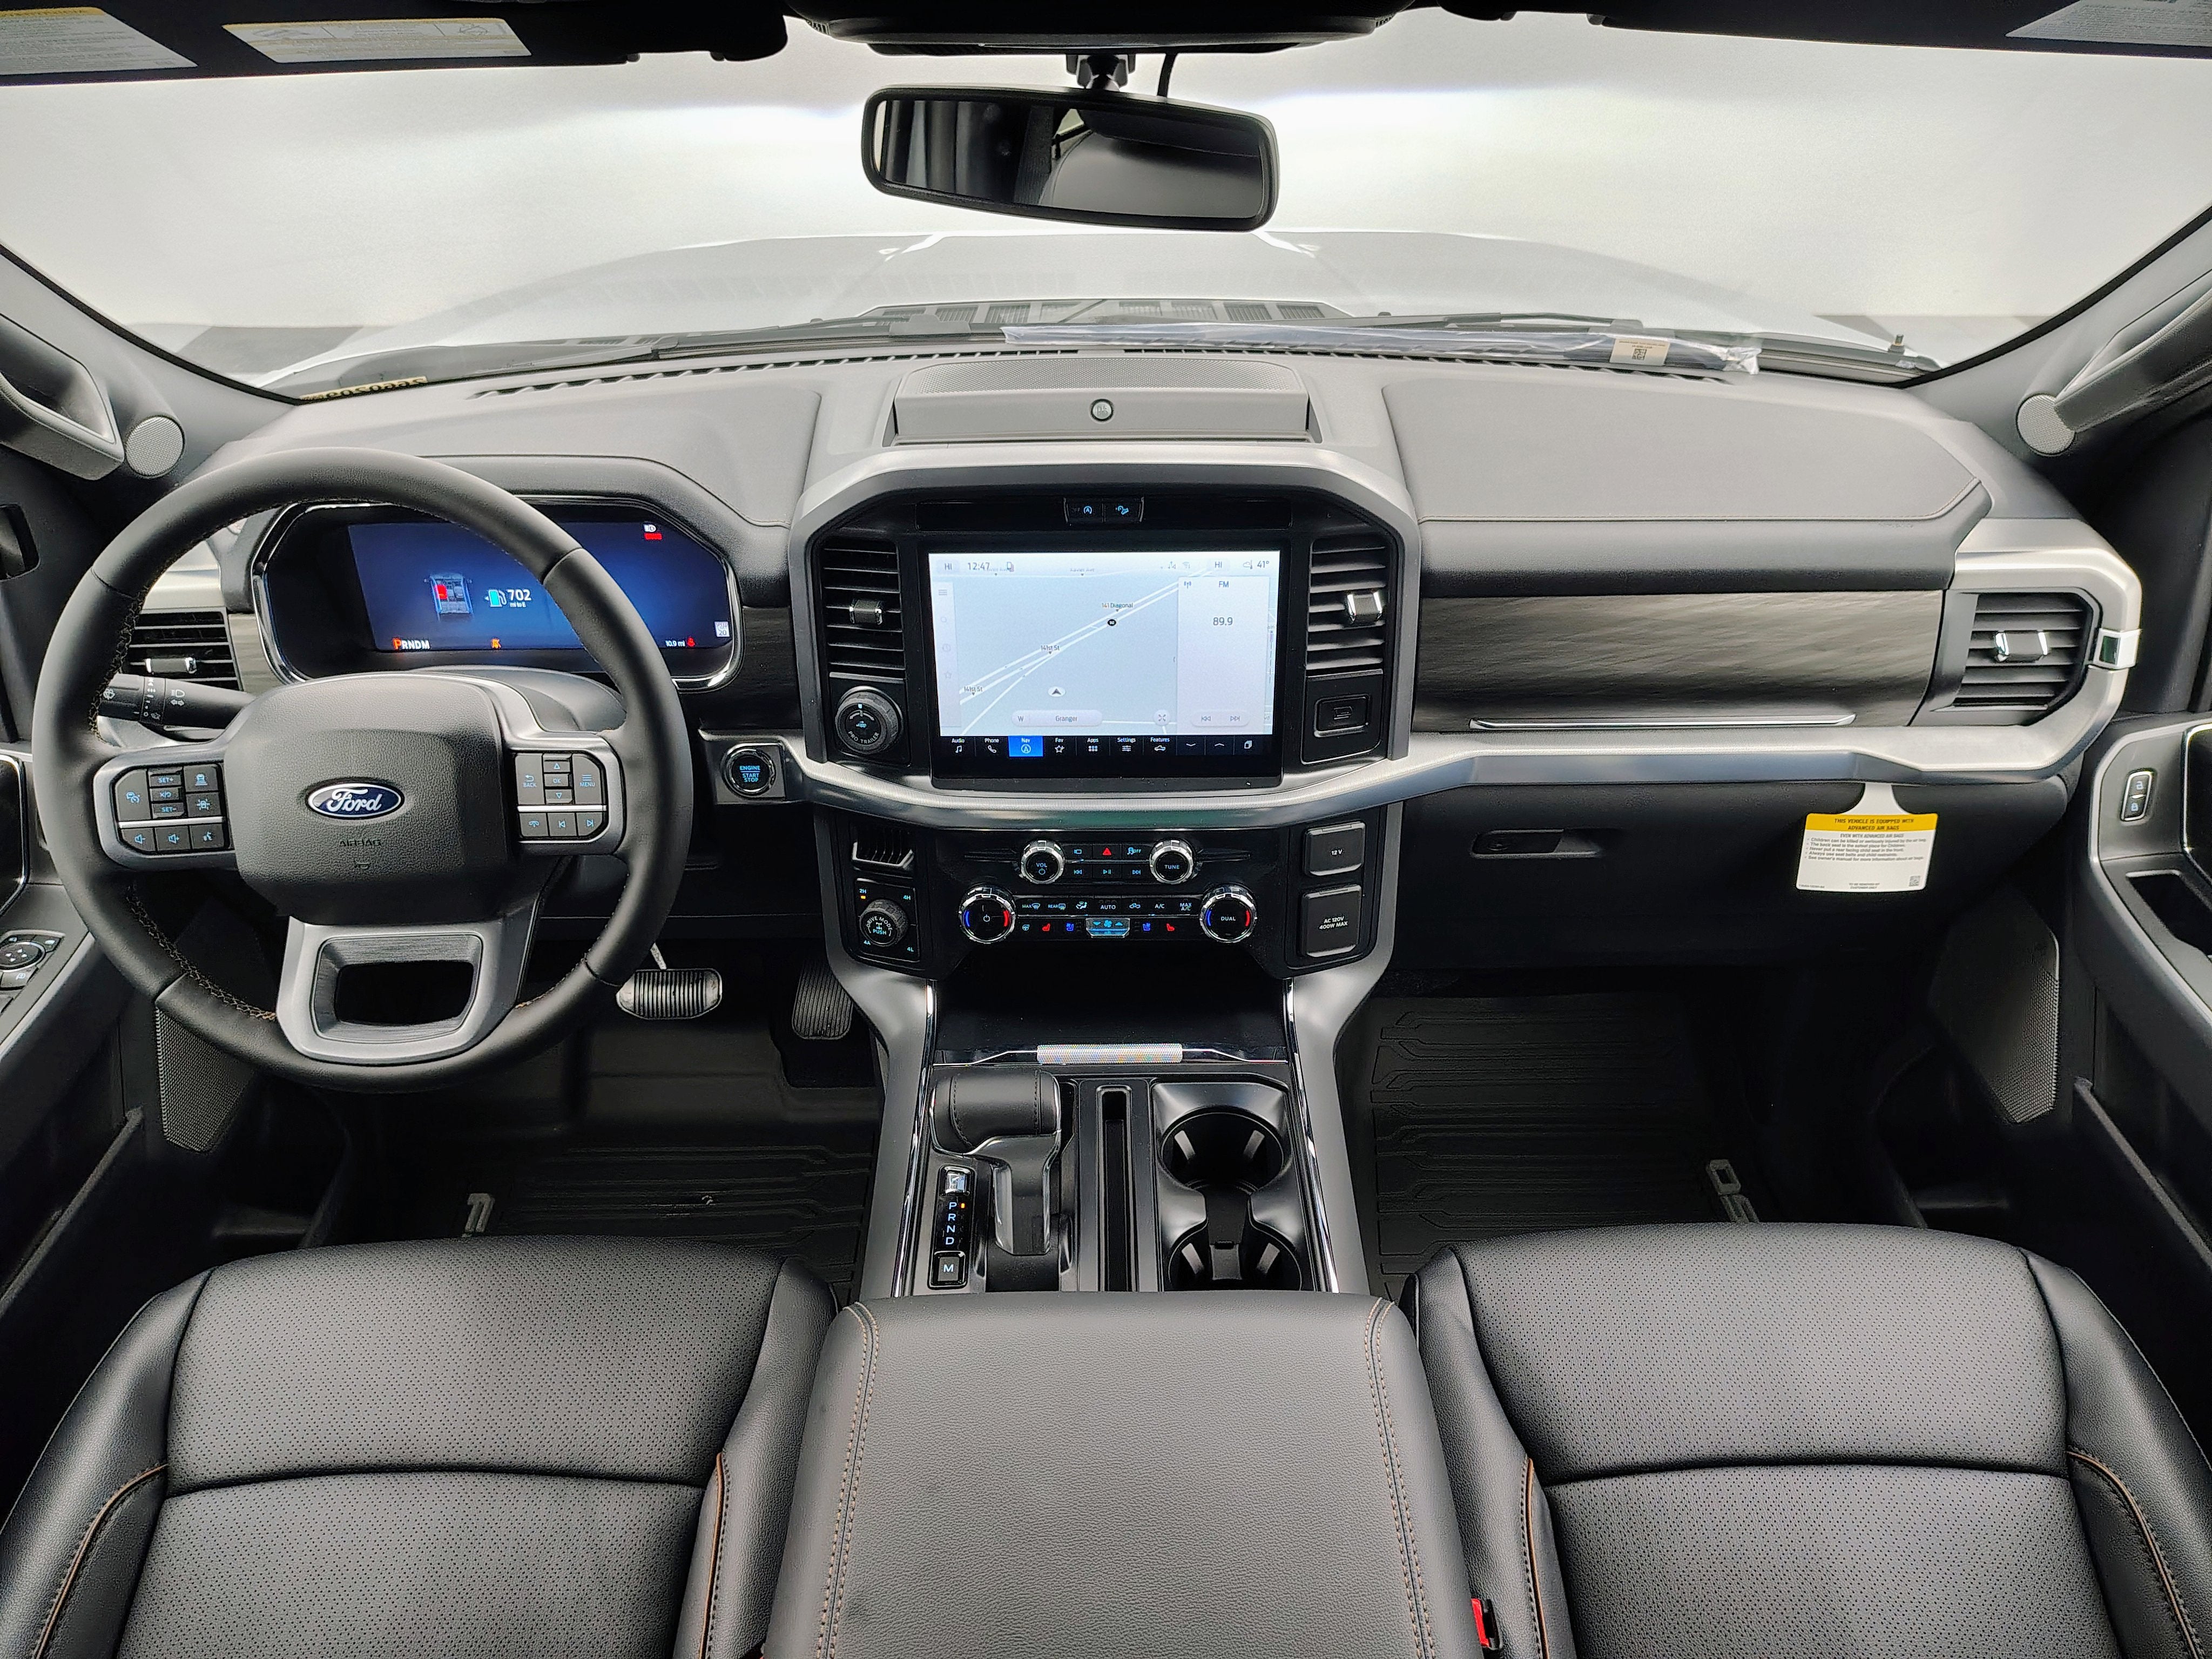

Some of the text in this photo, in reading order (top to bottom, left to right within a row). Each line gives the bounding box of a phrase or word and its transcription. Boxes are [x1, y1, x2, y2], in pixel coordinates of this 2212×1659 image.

[945, 562, 952, 570] HI
[967, 562, 990, 571] 12:47
[506, 589, 532, 601] 702
[1213, 617, 1233, 626] 89.9
[848, 731, 880, 744] PRO TRAILER
[326, 788, 382, 812] Ford
[866, 916, 893, 930] DRIVE MODE
[948, 1202, 957, 1210] P
[947, 1213, 956, 1221] R
[946, 1225, 955, 1233] N
[945, 1237, 954, 1245] D
[943, 1264, 954, 1272] M
